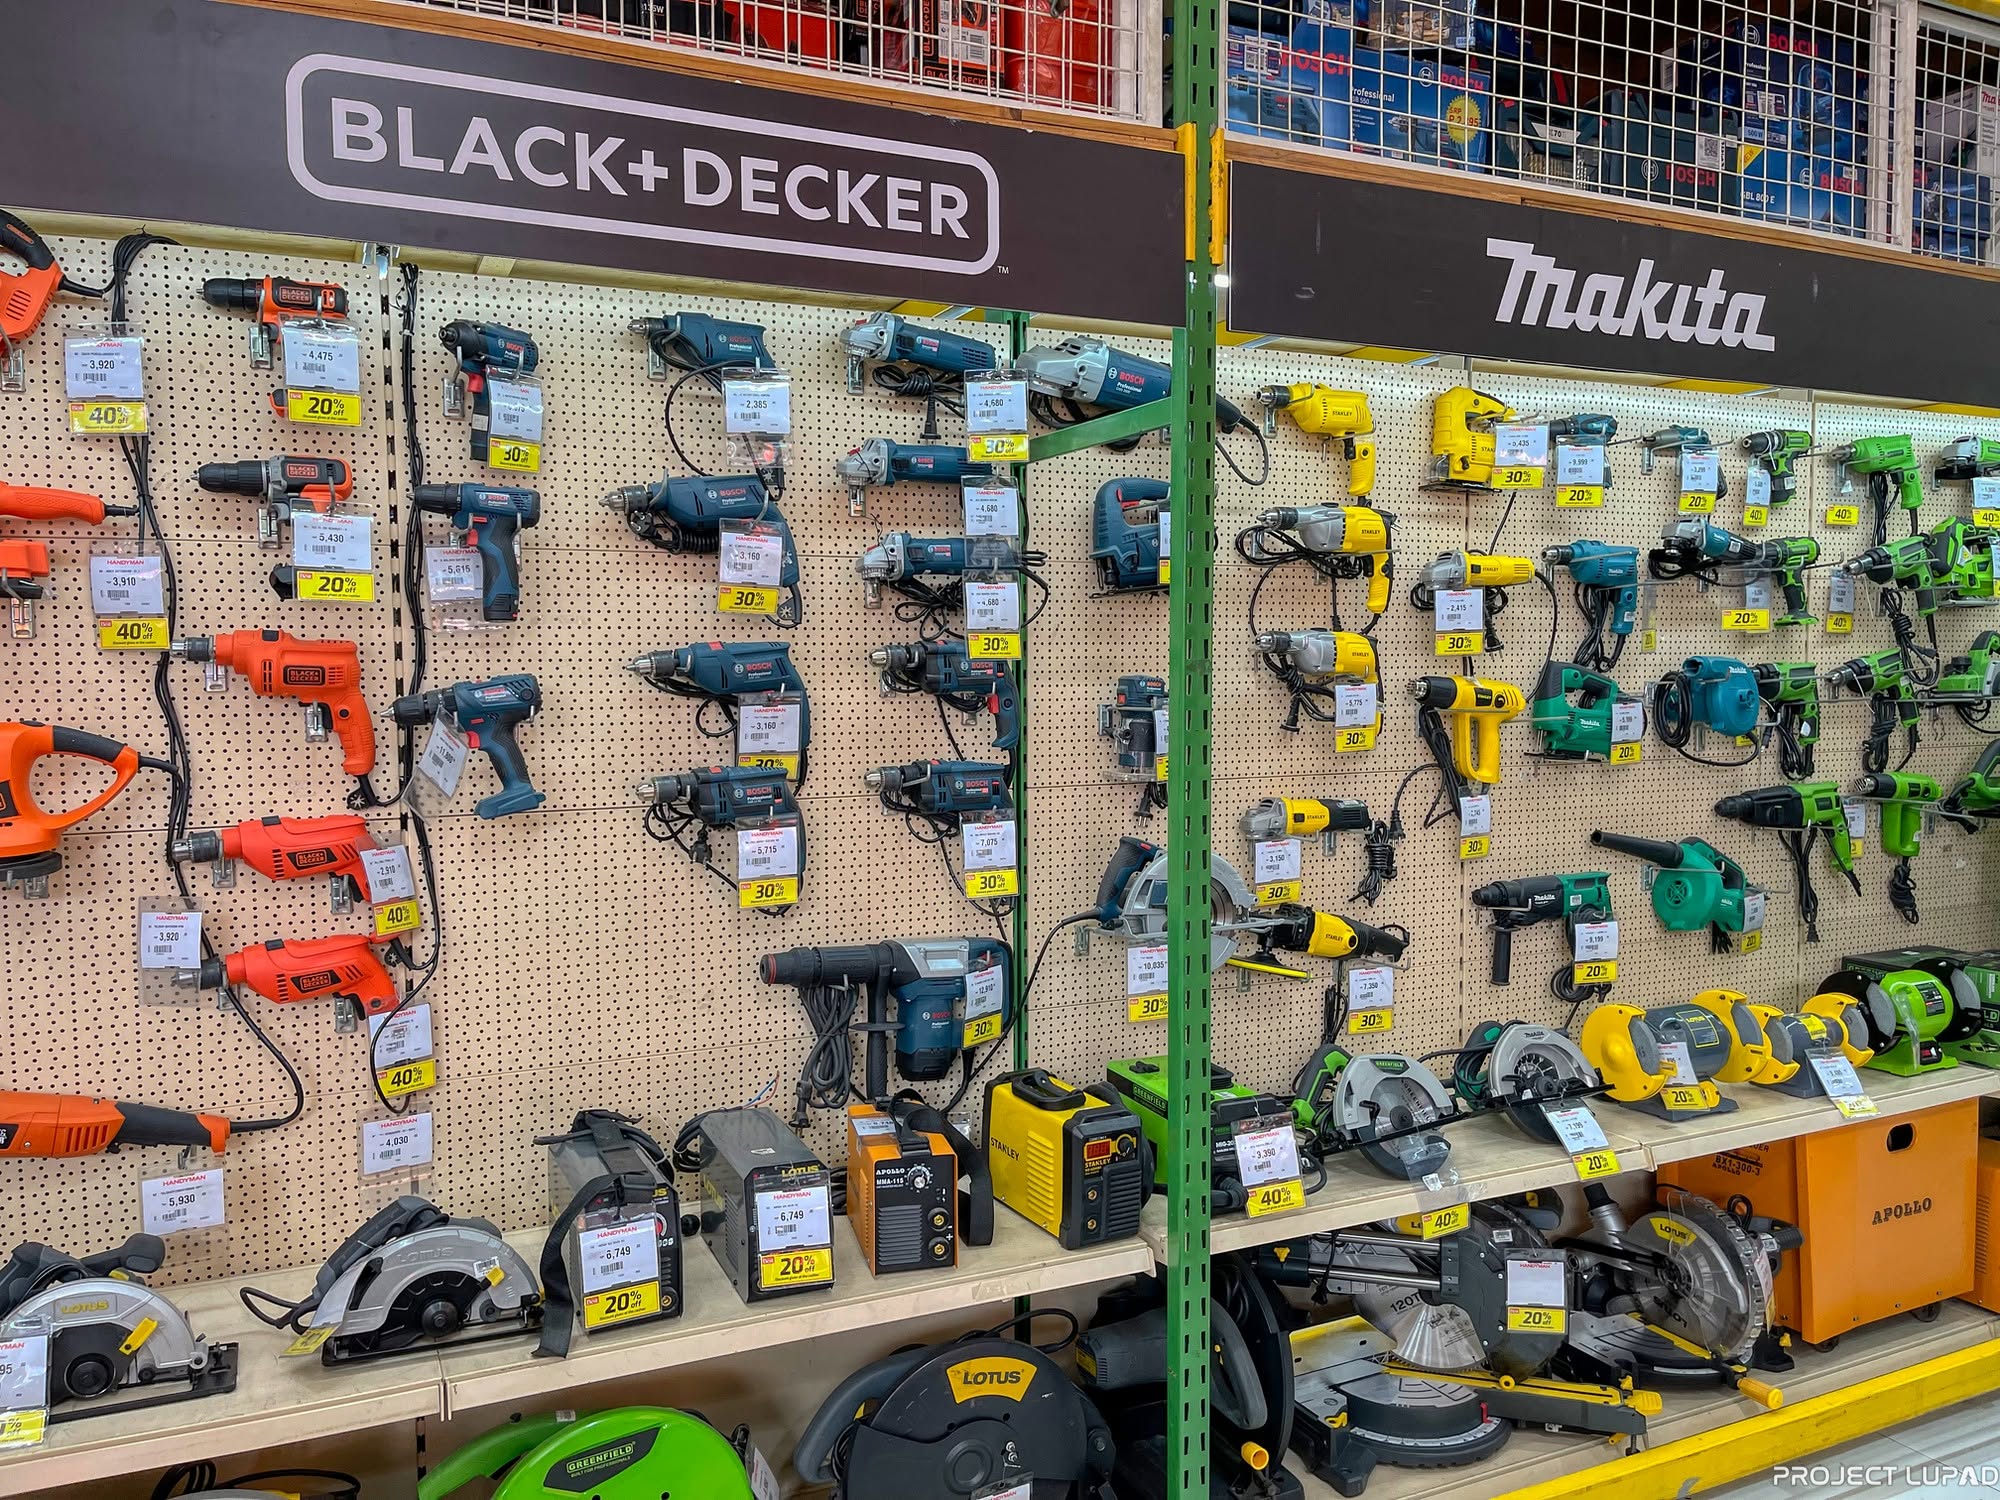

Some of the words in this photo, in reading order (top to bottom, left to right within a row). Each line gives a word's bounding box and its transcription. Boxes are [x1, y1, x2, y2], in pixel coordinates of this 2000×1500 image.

[308, 350, 333, 361] 4,475
[90, 360, 115, 370] 3,920
[1120, 372, 1145, 385] BOSCH
[1117, 382, 1143, 392] Professional
[307, 397, 344, 414] 20%
[746, 399, 768, 409] 2,385
[984, 399, 1003, 408] 4,680
[89, 406, 130, 424] 40%
[986, 438, 1015, 453] 30%
[1505, 470, 1531, 483] 30%
[720, 488, 747, 496] BOSCH
[1569, 489, 1592, 501] 20%
[981, 504, 998, 513] 4,680
[319, 533, 344, 543] 5,430
[113, 577, 136, 587] 3,910
[319, 576, 357, 592] 20%
[734, 592, 765, 606] 30%
[982, 598, 999, 607] 4,680
[1451, 604, 1467, 612] 2,415
[117, 623, 153, 640] 40%
[983, 637, 1008, 651] 30%
[1448, 637, 1472, 649] 30%
[756, 721, 776, 730] 3,160
[1346, 732, 1366, 745] 30%
[746, 787, 771, 796] BOSCH
[980, 838, 998, 846] 7,075
[299, 851, 323, 861] BLACK+
[758, 845, 777, 855] 5,715
[298, 856, 325, 866] DECKER
[1270, 854, 1285, 863] 3,150
[980, 875, 1005, 890] 30%
[755, 883, 784, 898] 30%
[1267, 885, 1290, 899] 30%
[387, 905, 409, 924] 40%
[160, 932, 179, 942] 3,920
[1144, 962, 1165, 971] 10,035
[1586, 965, 1608, 977] 20%
[303, 974, 327, 983] BLACK+
[303, 980, 329, 989] DECKER
[1142, 997, 1167, 1014] 30%
[1361, 1013, 1383, 1027] 30%
[974, 1020, 993, 1036] 30%
[391, 1067, 422, 1087] 40%
[1133, 1087, 1166, 1111] GREENFIELD
[1673, 1089, 1692, 1103] 20%
[381, 1118, 418, 1128] HANDYMAN
[386, 1136, 409, 1147] 4,030
[1249, 1131, 1280, 1141] HANDYMAN
[991, 1138, 1020, 1161] STANLEY
[1085, 1159, 1110, 1168] STANLEY
[1585, 1154, 1608, 1170] 20%
[1712, 1162, 1740, 1175] APOLLO
[1715, 1155, 1760, 1176] BX1-300-3
[781, 1164, 819, 1175] LOTUS
[163, 1175, 206, 1186] HANDYMAN
[169, 1194, 196, 1207] 5,930
[773, 1192, 811, 1200] HANDYMAN
[1261, 1187, 1291, 1205] 40%
[780, 1210, 804, 1221] 6,749
[1872, 1198, 1932, 1225] APOLLO
[1435, 1210, 1459, 1227] 40%
[598, 1226, 638, 1239] HANDYMAN
[1660, 1223, 1687, 1239] LOTUS
[606, 1247, 631, 1259] 6,749
[780, 1255, 815, 1276] 20%
[805, 1265, 815, 1273] off
[61, 1301, 109, 1314] LOTUS
[605, 1291, 642, 1314] 20%
[631, 1299, 642, 1308] off
[1391, 1293, 1423, 1313] 120T
[1523, 1311, 1552, 1324] 20%
[963, 1371, 1021, 1385] LOTUS
[568, 1444, 632, 1471] GREENFIELD
[571, 1469, 583, 1477] BUILT
[594, 1456, 631, 1472] PROFESSIONALS
